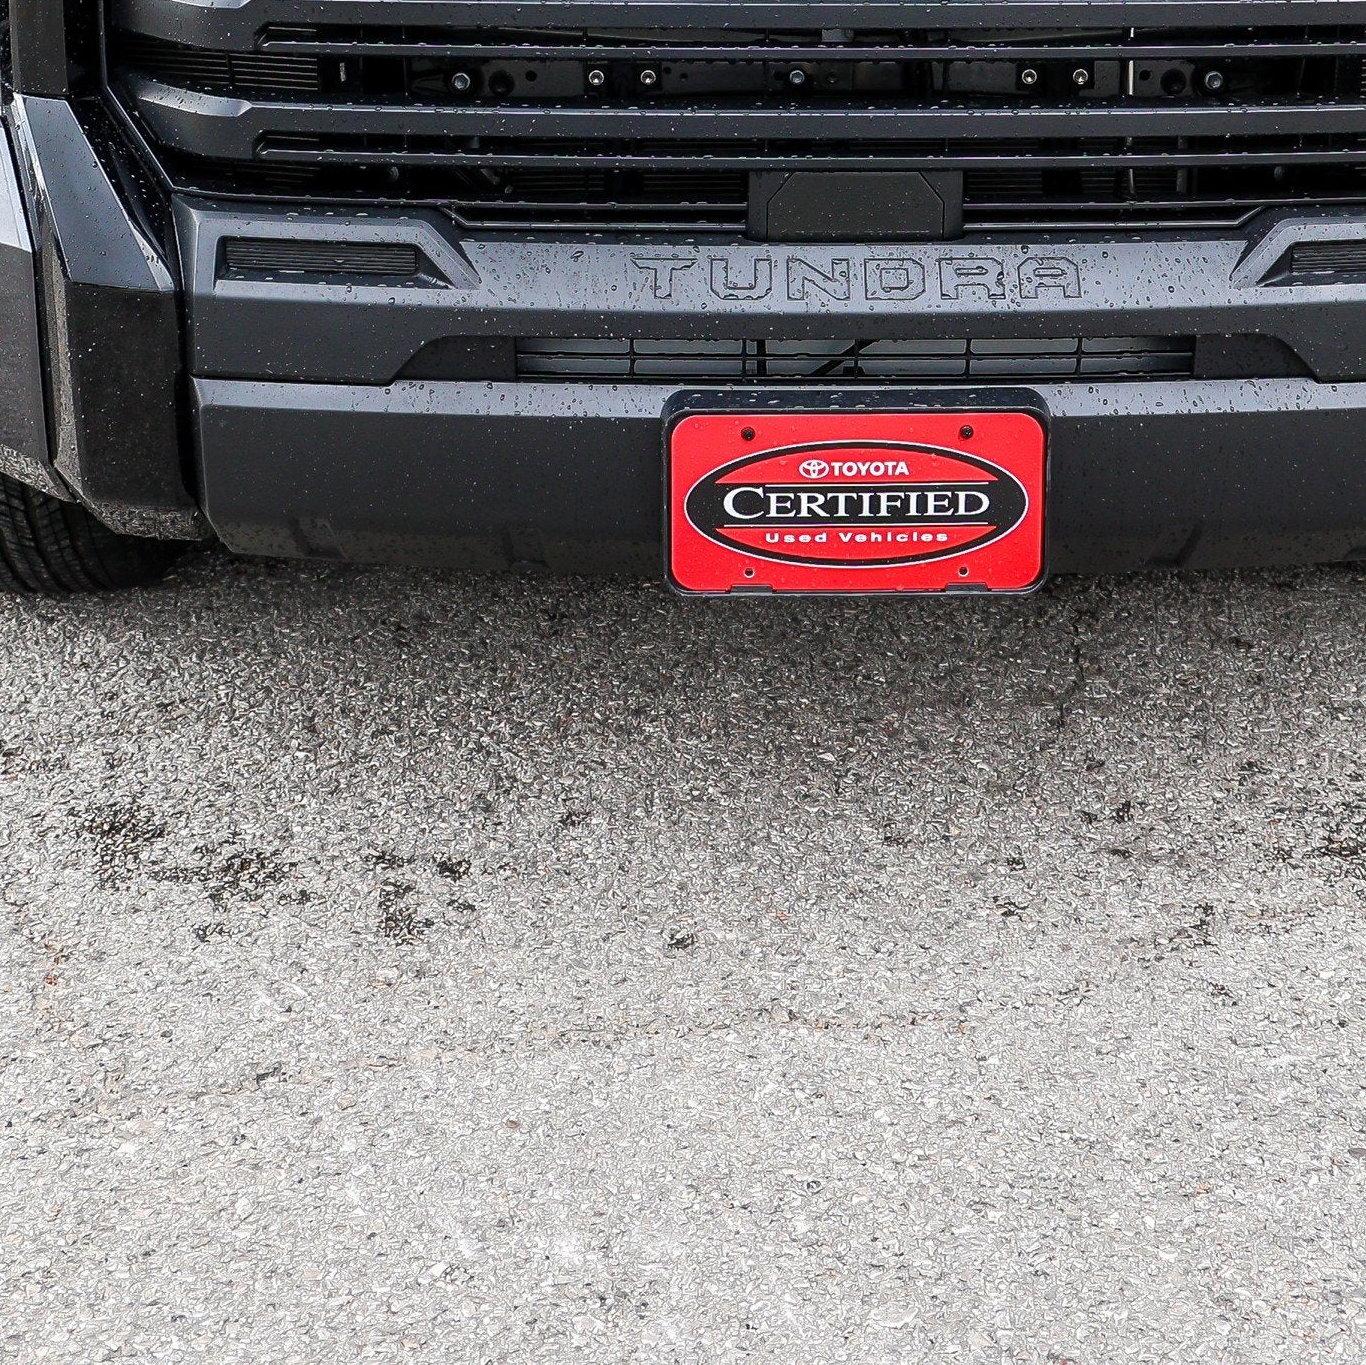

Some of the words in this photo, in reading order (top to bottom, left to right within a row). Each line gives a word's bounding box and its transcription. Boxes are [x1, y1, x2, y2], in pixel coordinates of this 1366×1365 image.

[630, 256, 1083, 301] TUNDRA
[831, 461, 909, 477] TOYOTA
[722, 486, 990, 520] CERTIFIED
[765, 532, 827, 543] Used
[838, 531, 949, 543] Vehicles
